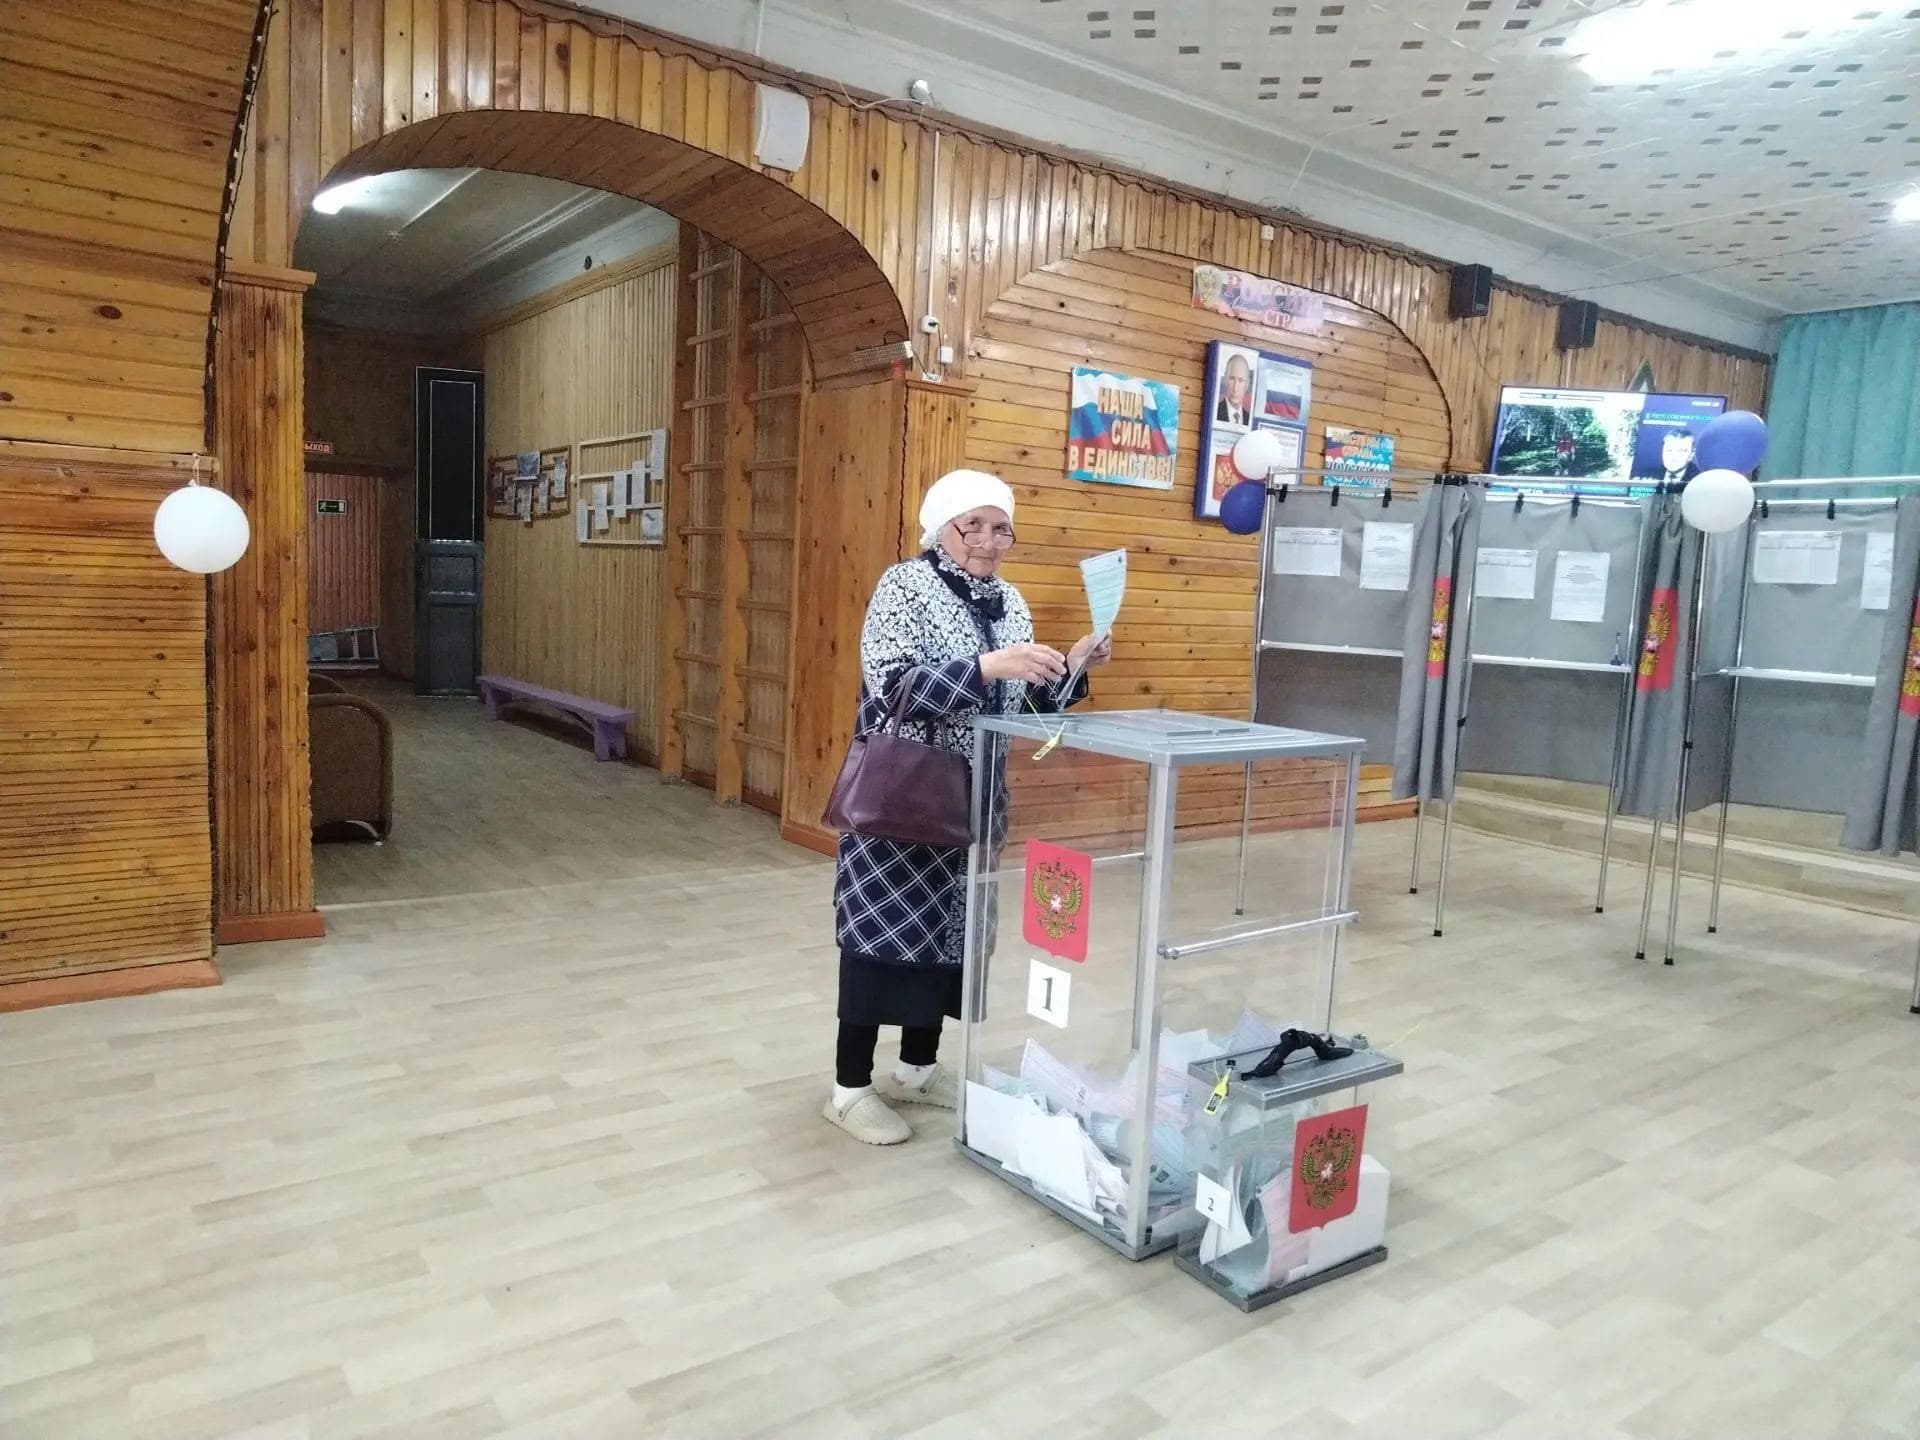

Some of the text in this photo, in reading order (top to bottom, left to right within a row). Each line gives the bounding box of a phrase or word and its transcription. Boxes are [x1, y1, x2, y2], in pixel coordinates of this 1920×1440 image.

[1097, 386, 1144, 419] НАША
[305, 442, 330, 454] ЫХОД
[1111, 419, 1152, 449] СИЛА
[1068, 444, 1081, 472] В
[1042, 977, 1055, 1012] 1
[1207, 1197, 1215, 1212] 2
